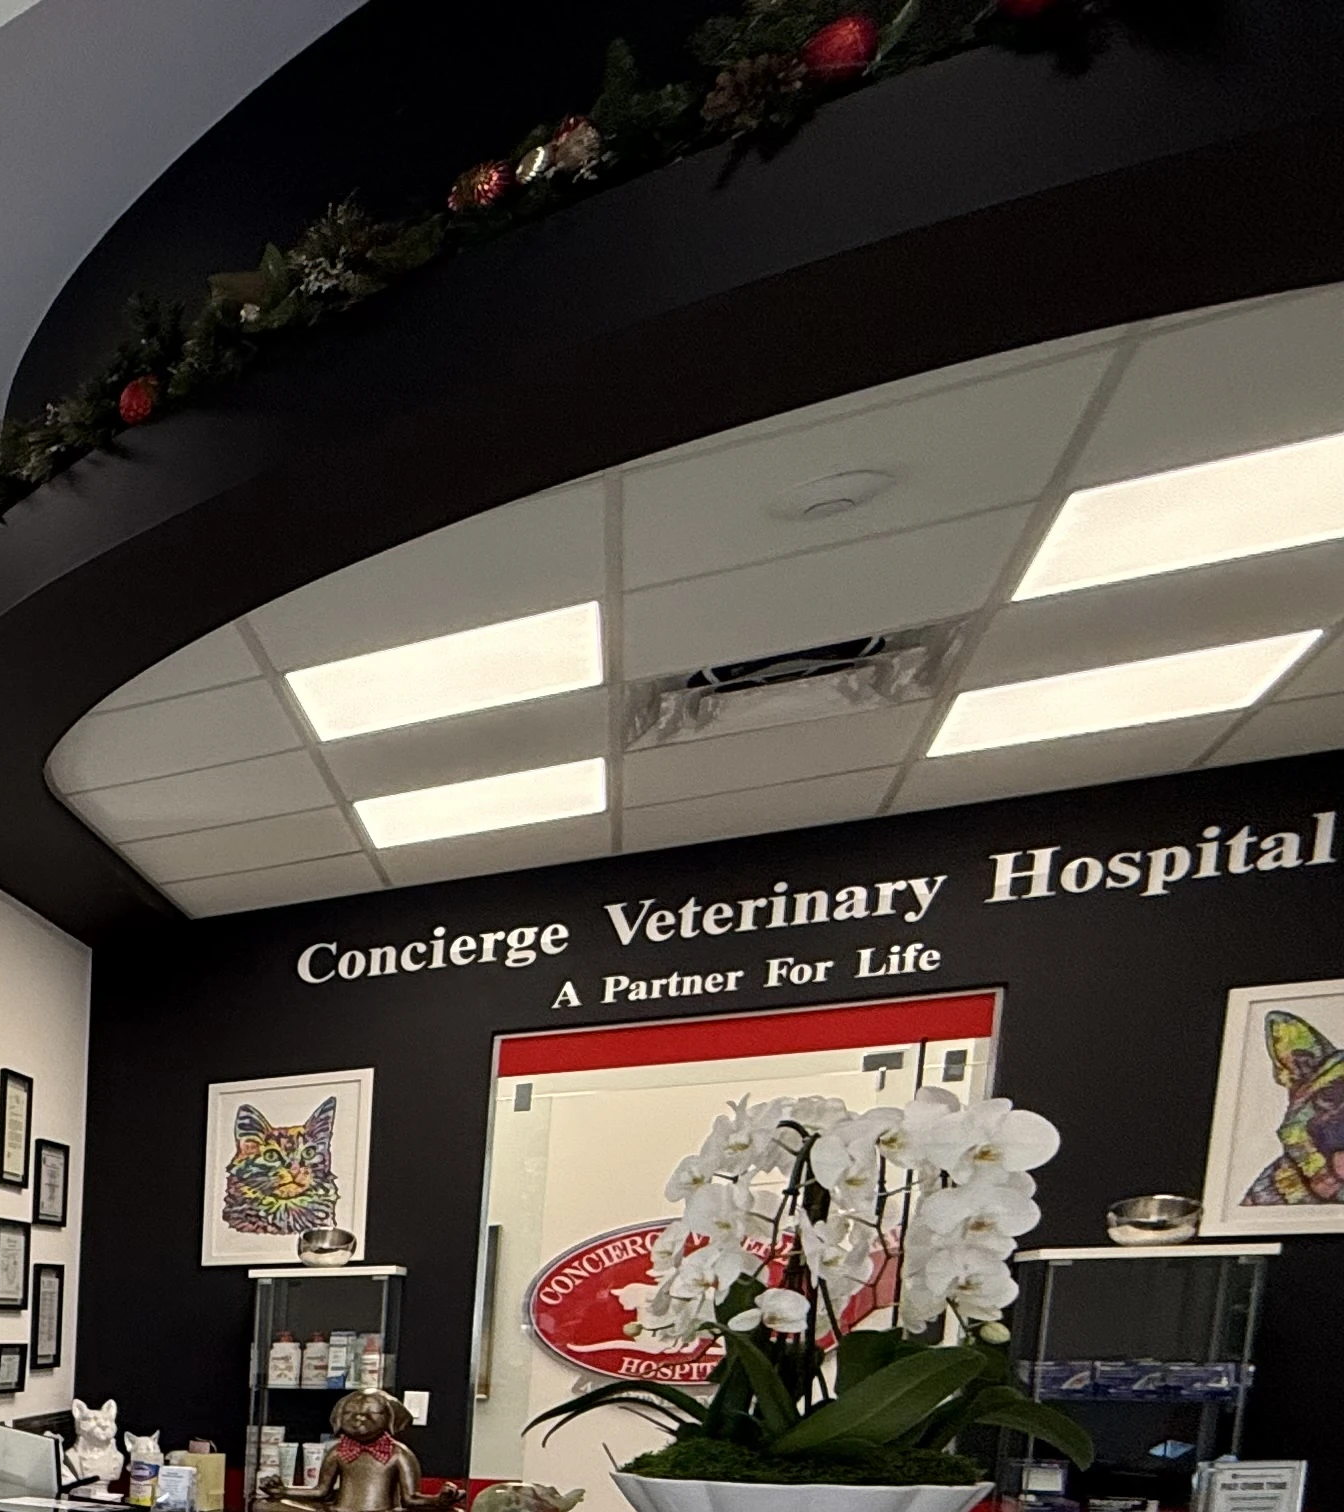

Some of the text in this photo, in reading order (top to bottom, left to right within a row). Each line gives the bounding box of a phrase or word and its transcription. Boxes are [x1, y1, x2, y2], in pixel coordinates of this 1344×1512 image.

[296, 810, 1337, 986] Concierge Veterinary Hospital
[551, 943, 942, 1009] A Partner For Life
[539, 1230, 663, 1306] CONCIER
[617, 1356, 717, 1382] HOSPIT
